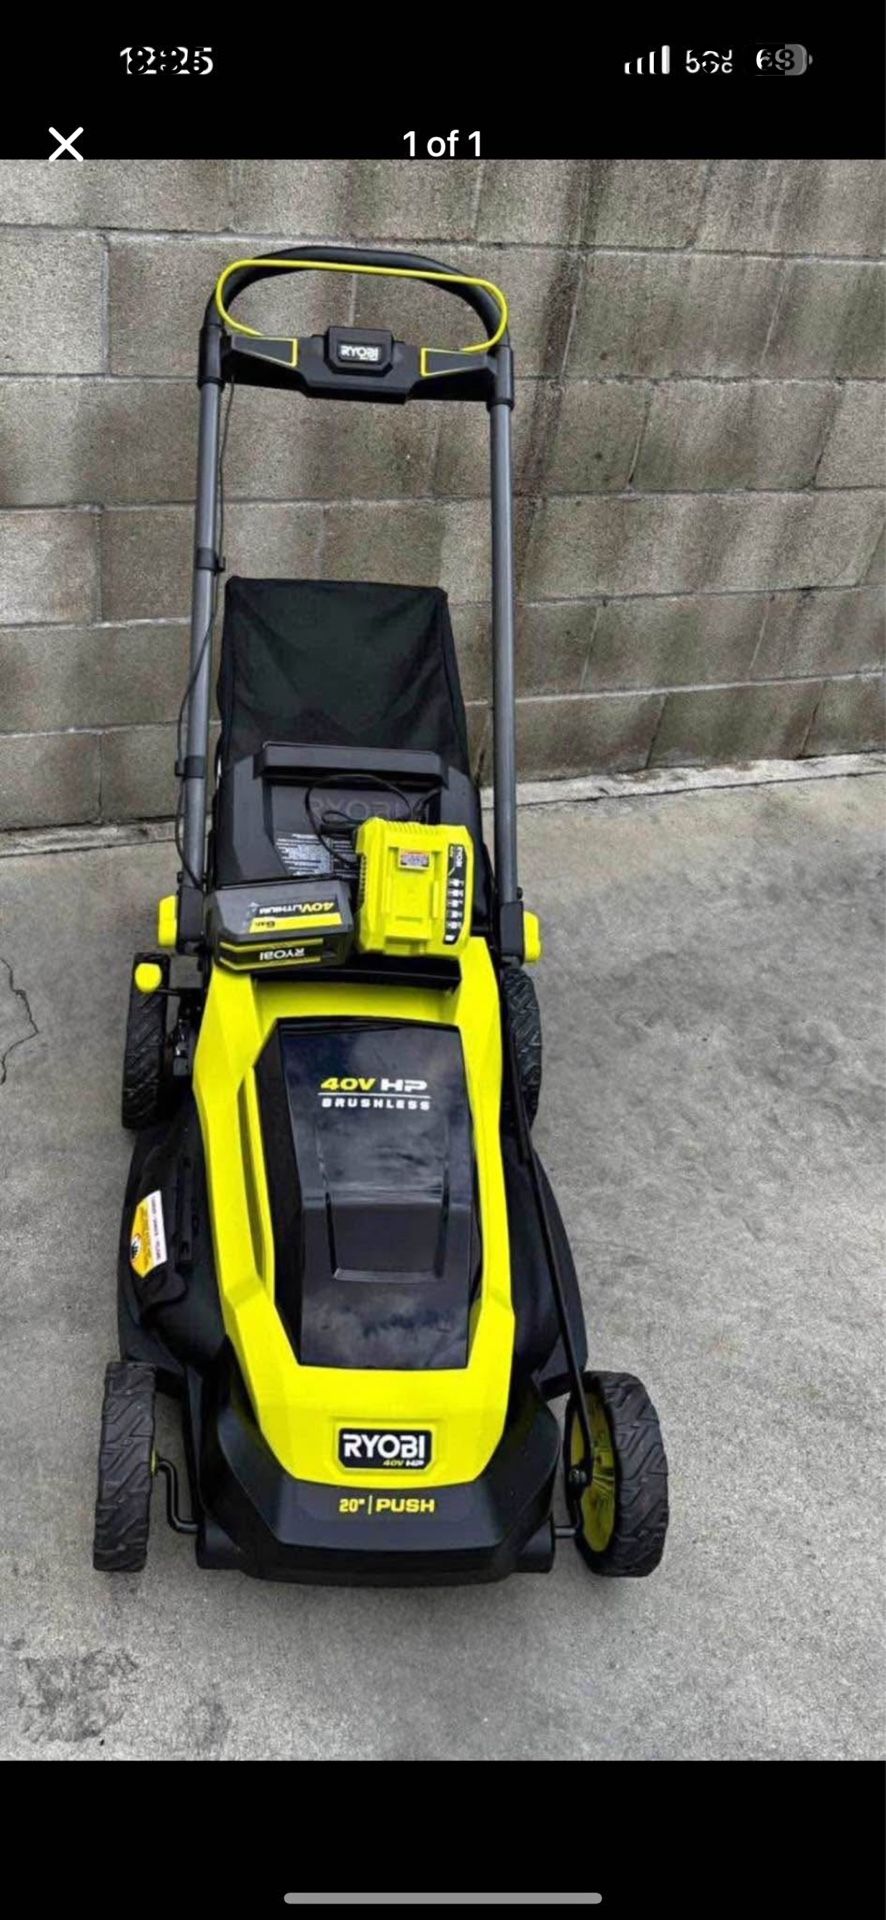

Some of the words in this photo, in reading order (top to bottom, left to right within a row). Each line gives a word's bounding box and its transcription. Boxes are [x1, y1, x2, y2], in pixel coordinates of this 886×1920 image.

[340, 345, 379, 358] RYOBI
[259, 947, 305, 961] RYOBI
[320, 1078, 376, 1091] 40V
[380, 1079, 428, 1092] HP
[321, 1098, 430, 1111] BRUSHLESS
[342, 1434, 426, 1459] RYOBI
[376, 1498, 436, 1513] PUSH
